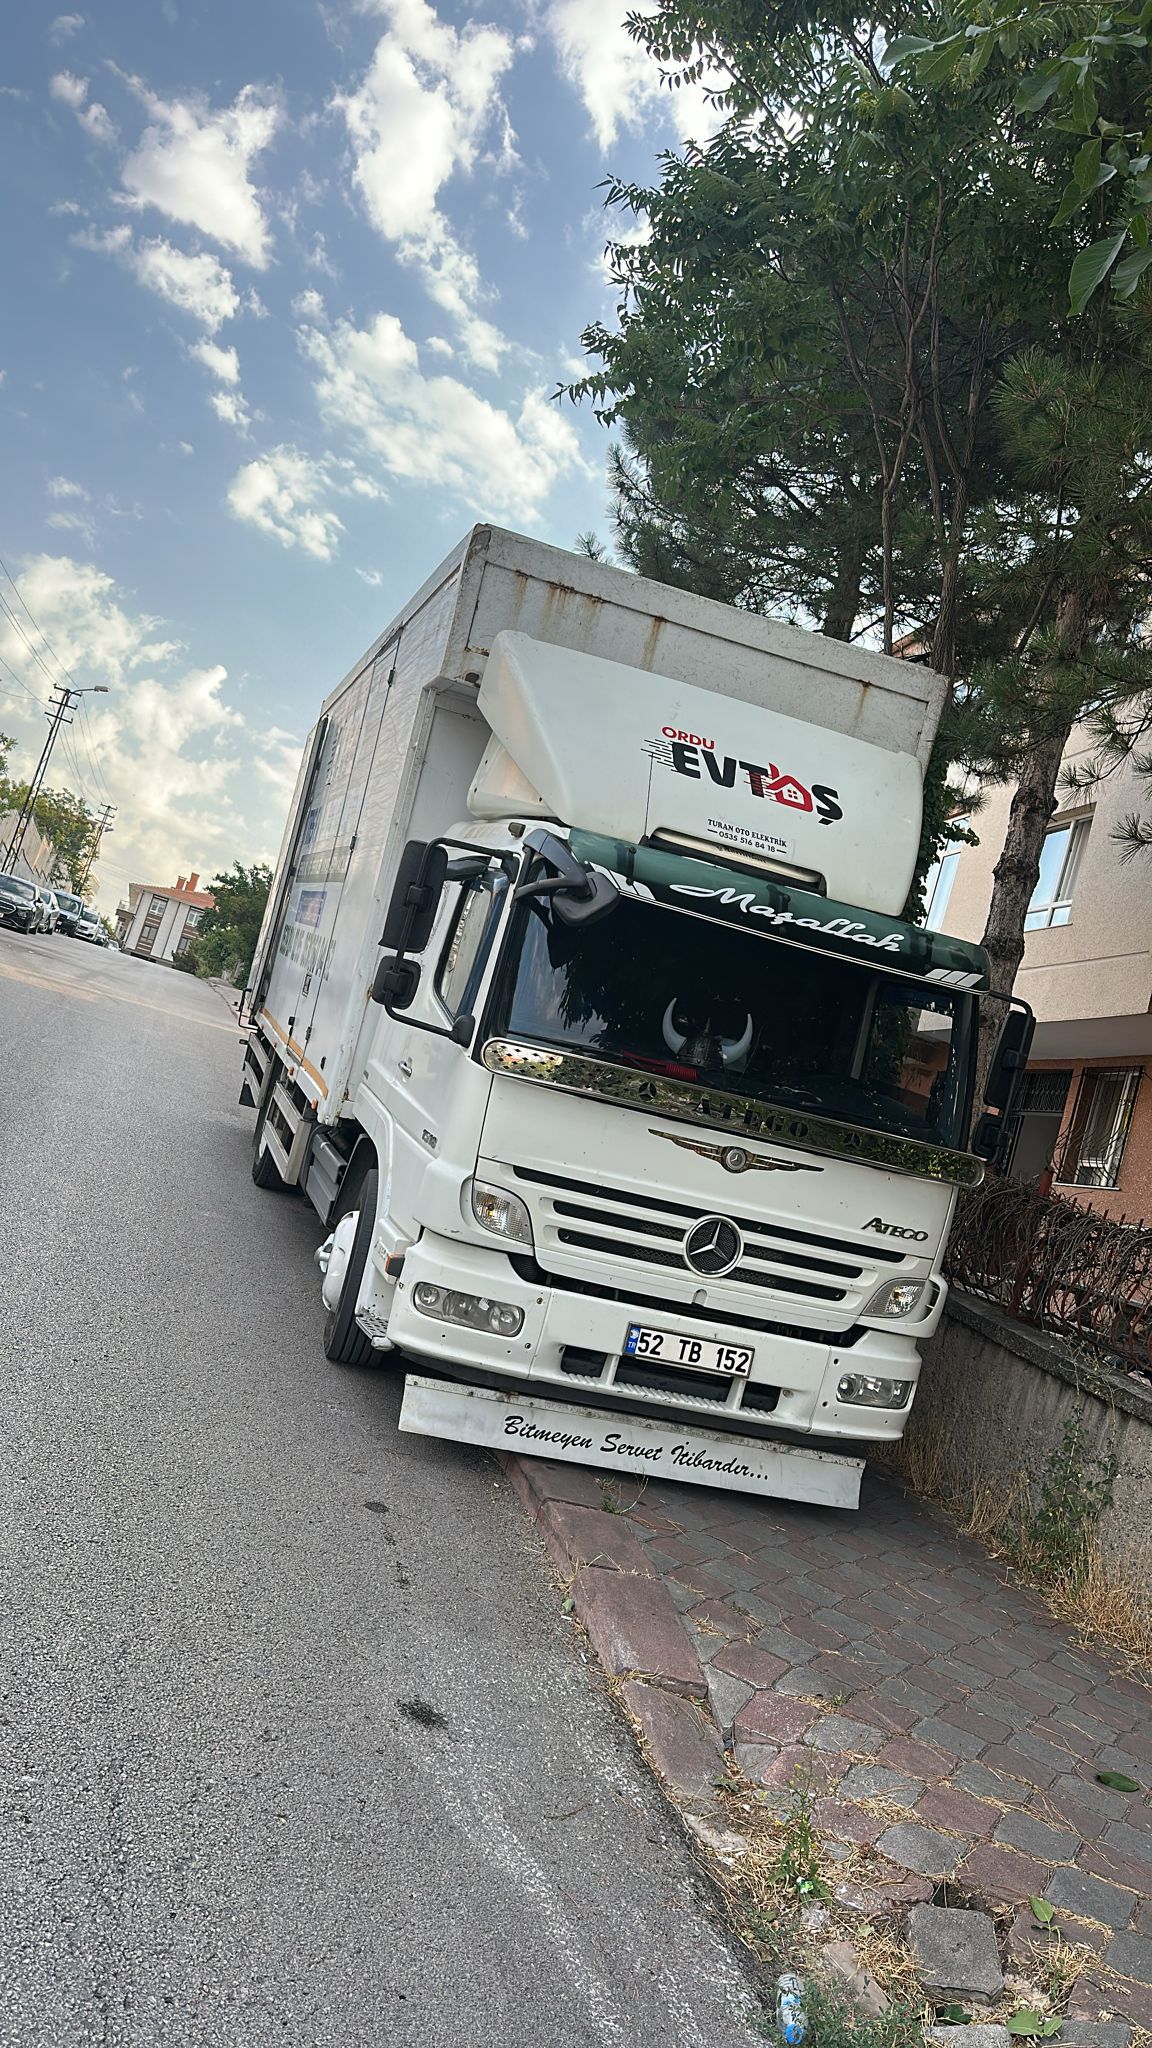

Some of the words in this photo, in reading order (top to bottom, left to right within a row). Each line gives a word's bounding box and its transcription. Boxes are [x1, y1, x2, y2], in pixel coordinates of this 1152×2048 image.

[662, 726, 715, 750] ORDU
[707, 818, 734, 832] TURAN
[735, 827, 750, 837] OTO
[751, 831, 787, 848] ELEKTRİK
[718, 831, 738, 842] 0535
[740, 837, 753, 846] 516
[755, 841, 765, 849] 84
[693, 1098, 809, 1138] ATEGO
[627, 1341, 636, 1349] TR
[637, 1331, 664, 1356] 52
[679, 1338, 703, 1363] TB
[716, 1347, 750, 1374] 152
[504, 1415, 593, 1450] Bitmeyen
[600, 1433, 663, 1461] Servet
